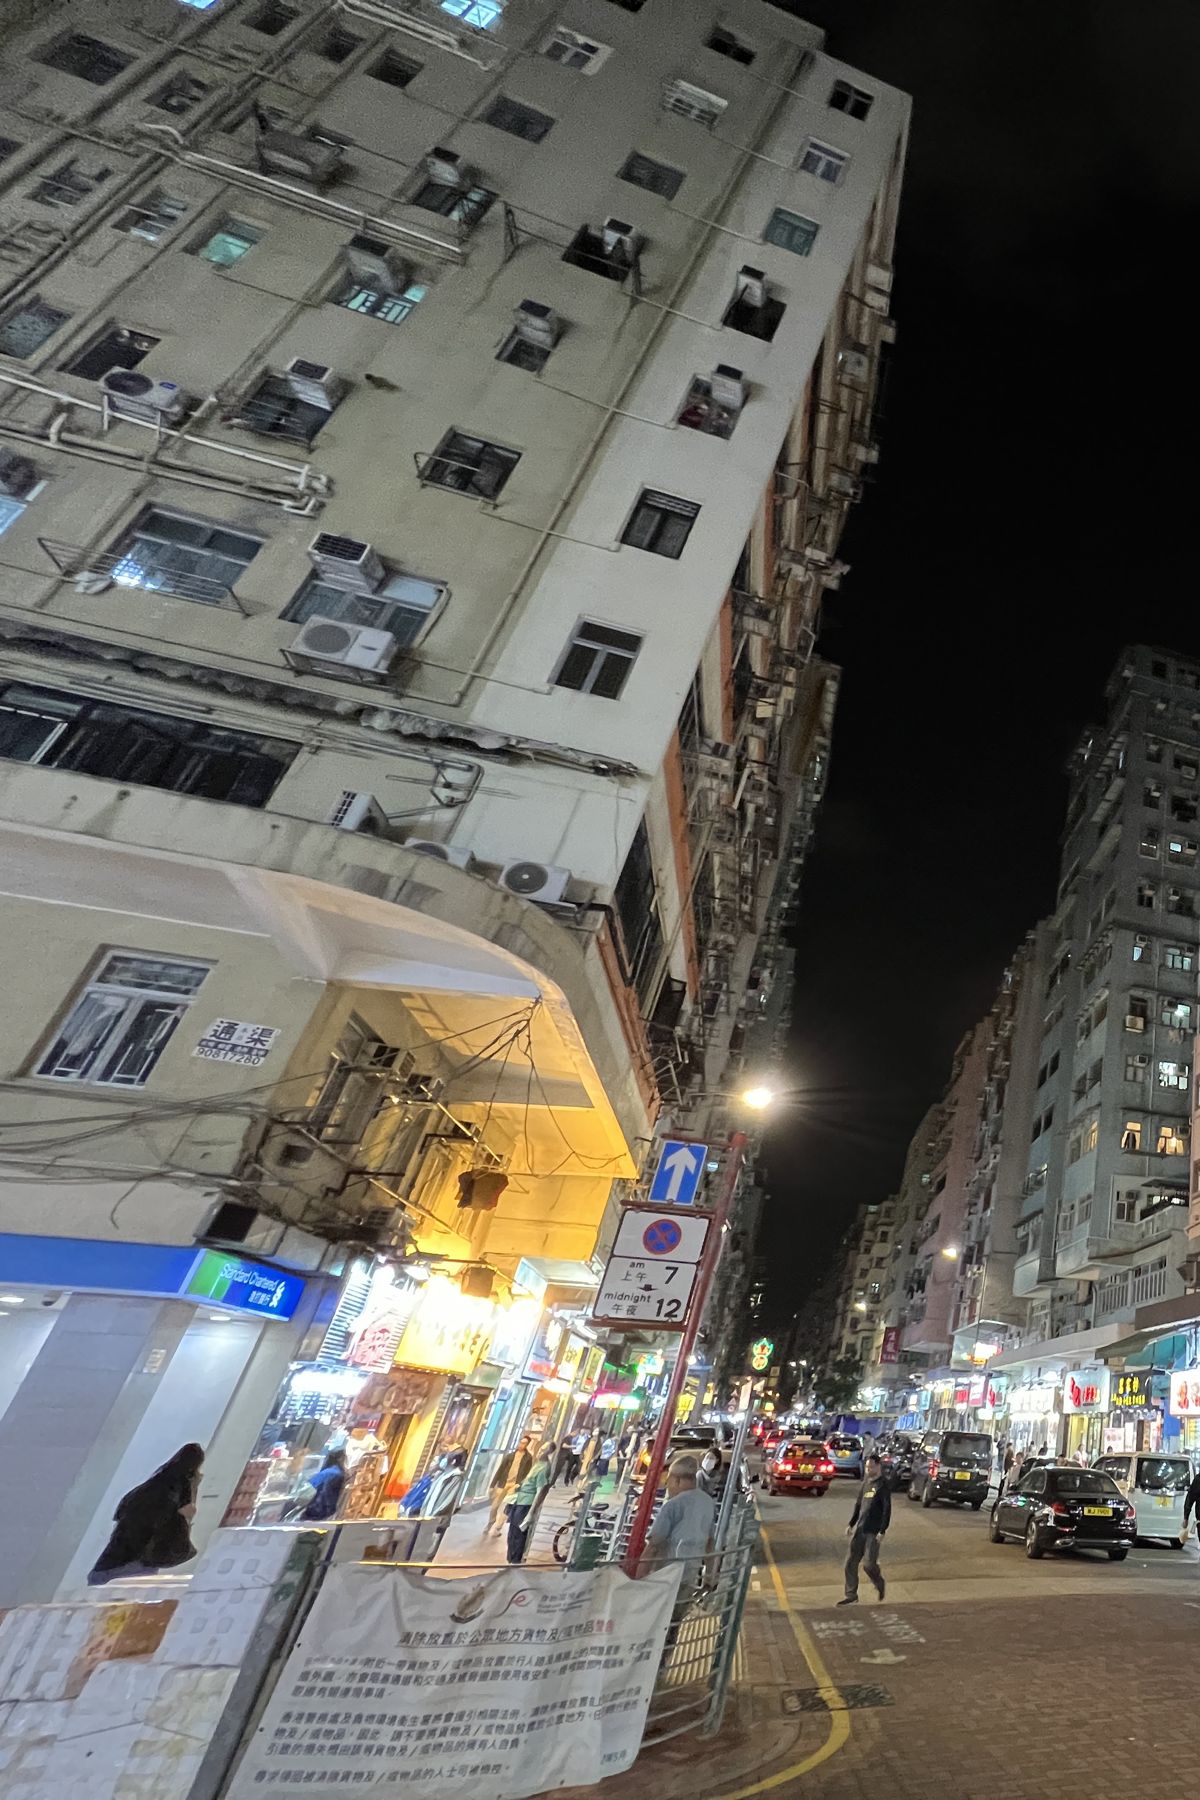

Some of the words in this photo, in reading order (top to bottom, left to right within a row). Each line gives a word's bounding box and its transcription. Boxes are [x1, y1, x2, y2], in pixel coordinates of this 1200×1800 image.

[629, 1261, 645, 1269] am
[220, 1263, 252, 1284] Standard
[248, 1272, 280, 1292] Chartered
[621, 1270, 647, 1282] 上午
[664, 1266, 679, 1285] 7
[604, 1291, 652, 1304] midnight
[611, 1303, 638, 1316] 午夜
[655, 1298, 682, 1318] 12
